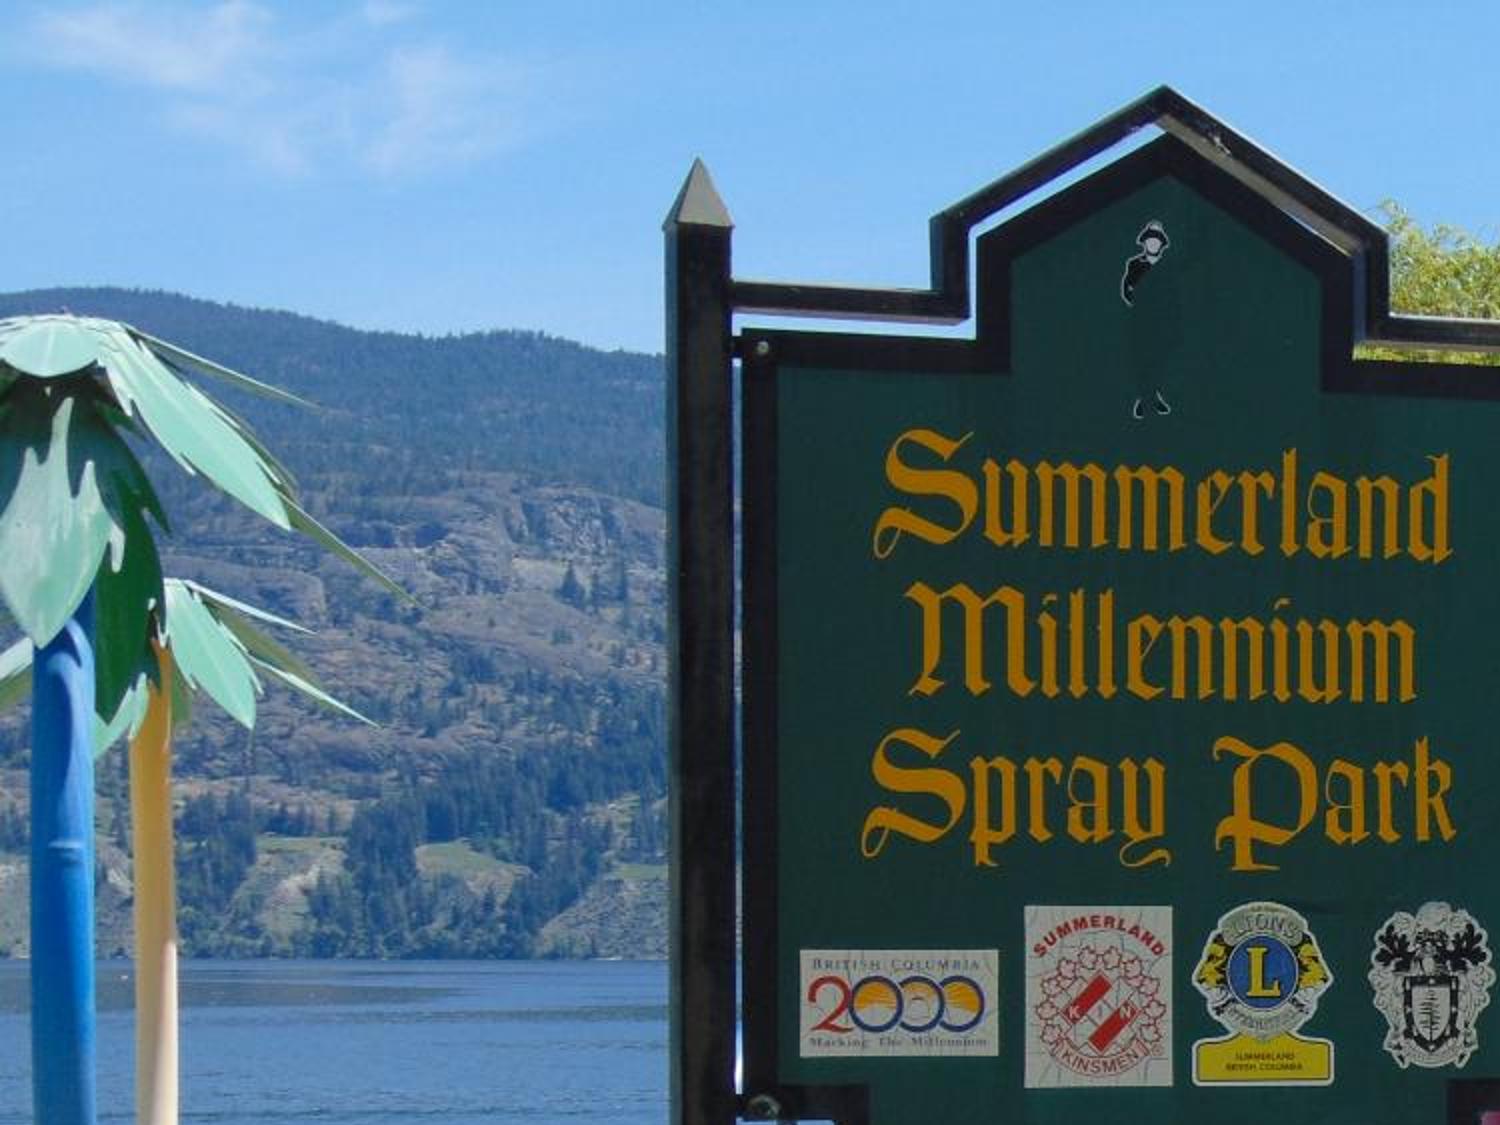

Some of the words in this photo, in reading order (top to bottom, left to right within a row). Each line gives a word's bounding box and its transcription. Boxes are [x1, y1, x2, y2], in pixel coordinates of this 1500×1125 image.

[872, 428, 1454, 566] Summerland
[904, 580, 1417, 704] Millennium
[860, 727, 1173, 869] Spray
[1211, 735, 1458, 873] Park
[1033, 915, 1165, 957] SUMMERLAND
[812, 959, 881, 970] BRITISH
[891, 959, 980, 970] COLUMBIA
[1246, 947, 1281, 997] L
[807, 975, 985, 1033] 2000
[1061, 1049, 1140, 1074] KINSMEN
